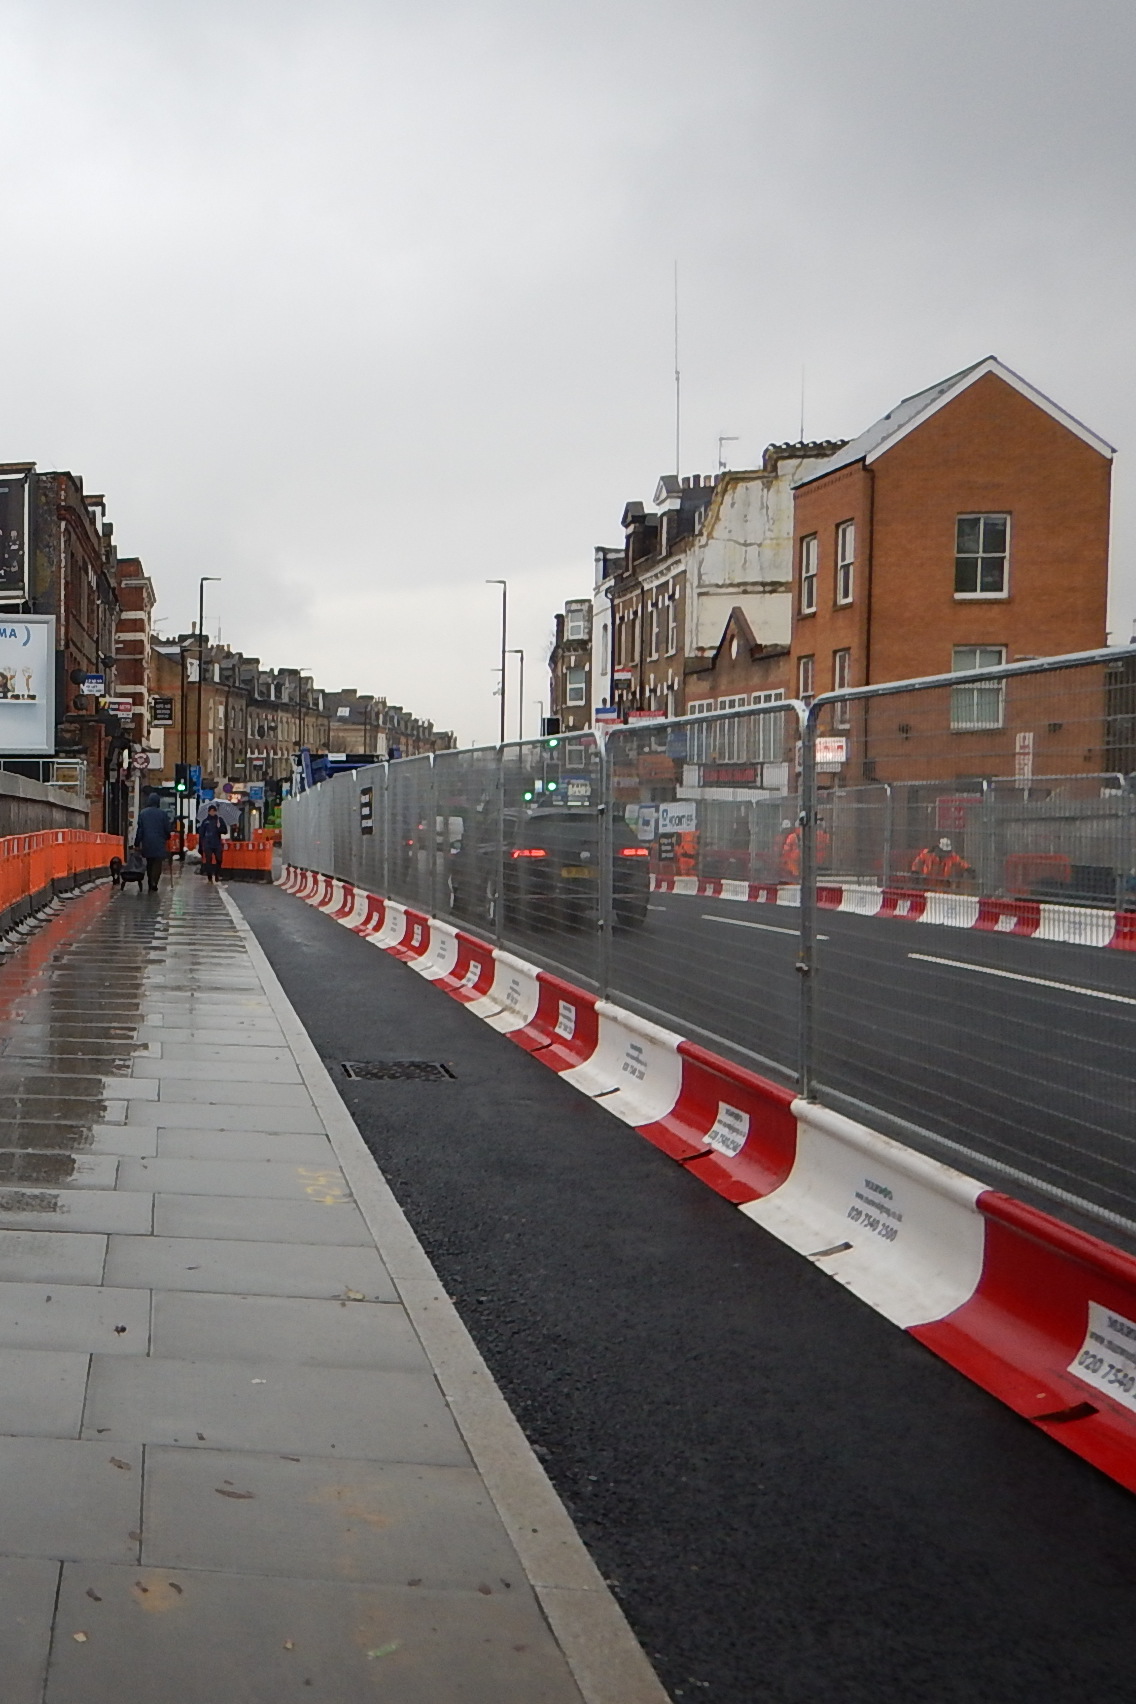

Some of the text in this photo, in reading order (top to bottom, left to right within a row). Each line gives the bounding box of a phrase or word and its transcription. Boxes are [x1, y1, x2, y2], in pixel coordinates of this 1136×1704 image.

[847, 1205, 863, 1223] 020
[860, 1212, 881, 1232] 7540
[1078, 1350, 1136, 1393] 020 7540
